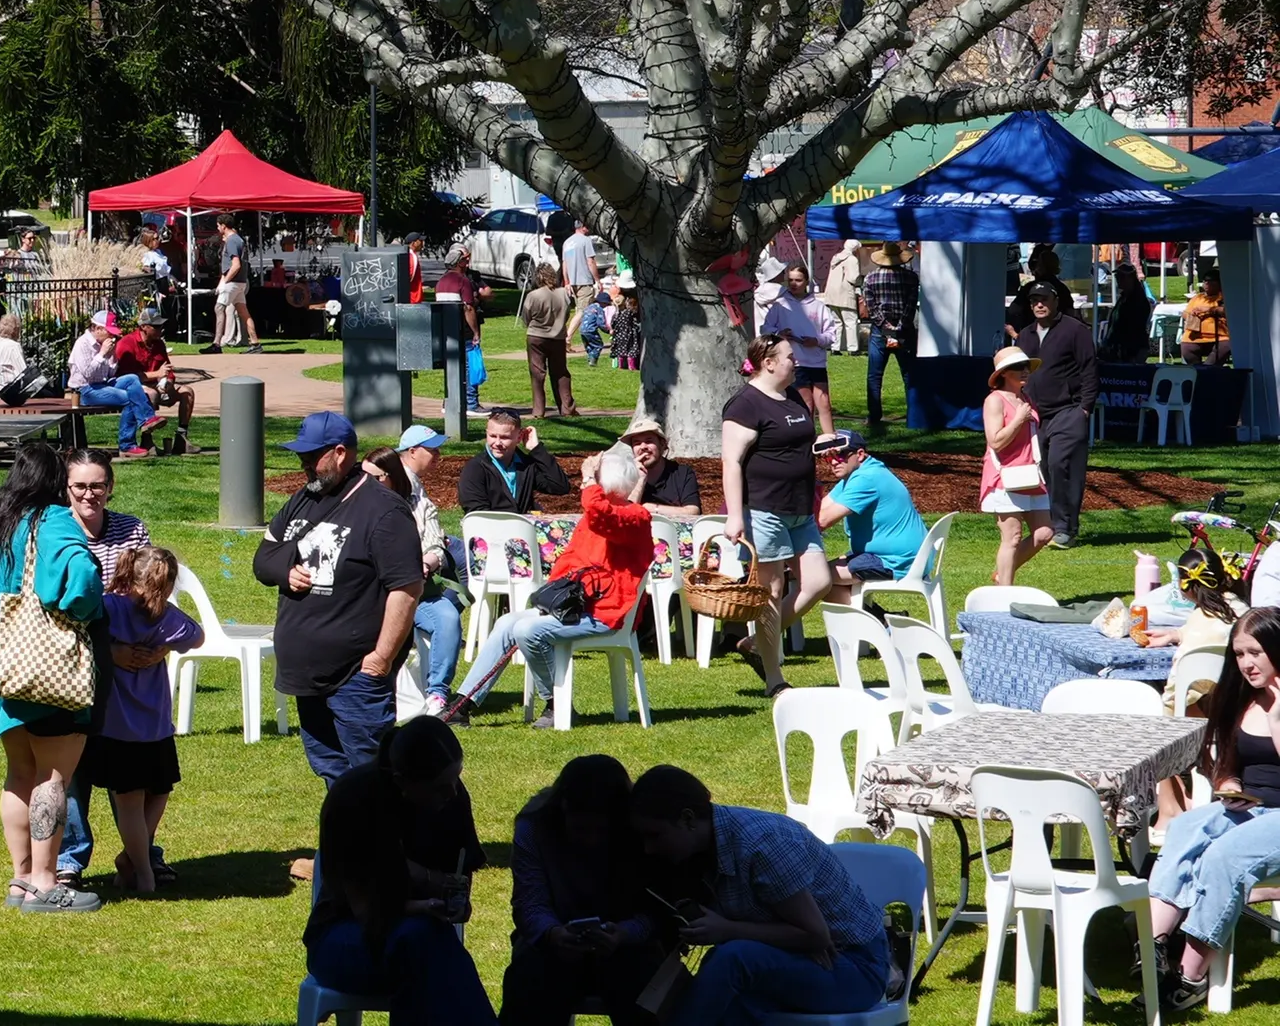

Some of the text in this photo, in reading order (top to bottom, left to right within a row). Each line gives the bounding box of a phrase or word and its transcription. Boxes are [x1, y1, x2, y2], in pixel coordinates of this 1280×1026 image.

[831, 185, 875, 204] Holy
[939, 192, 1056, 206] PARKES
[1099, 377, 1148, 387] Welcome to
